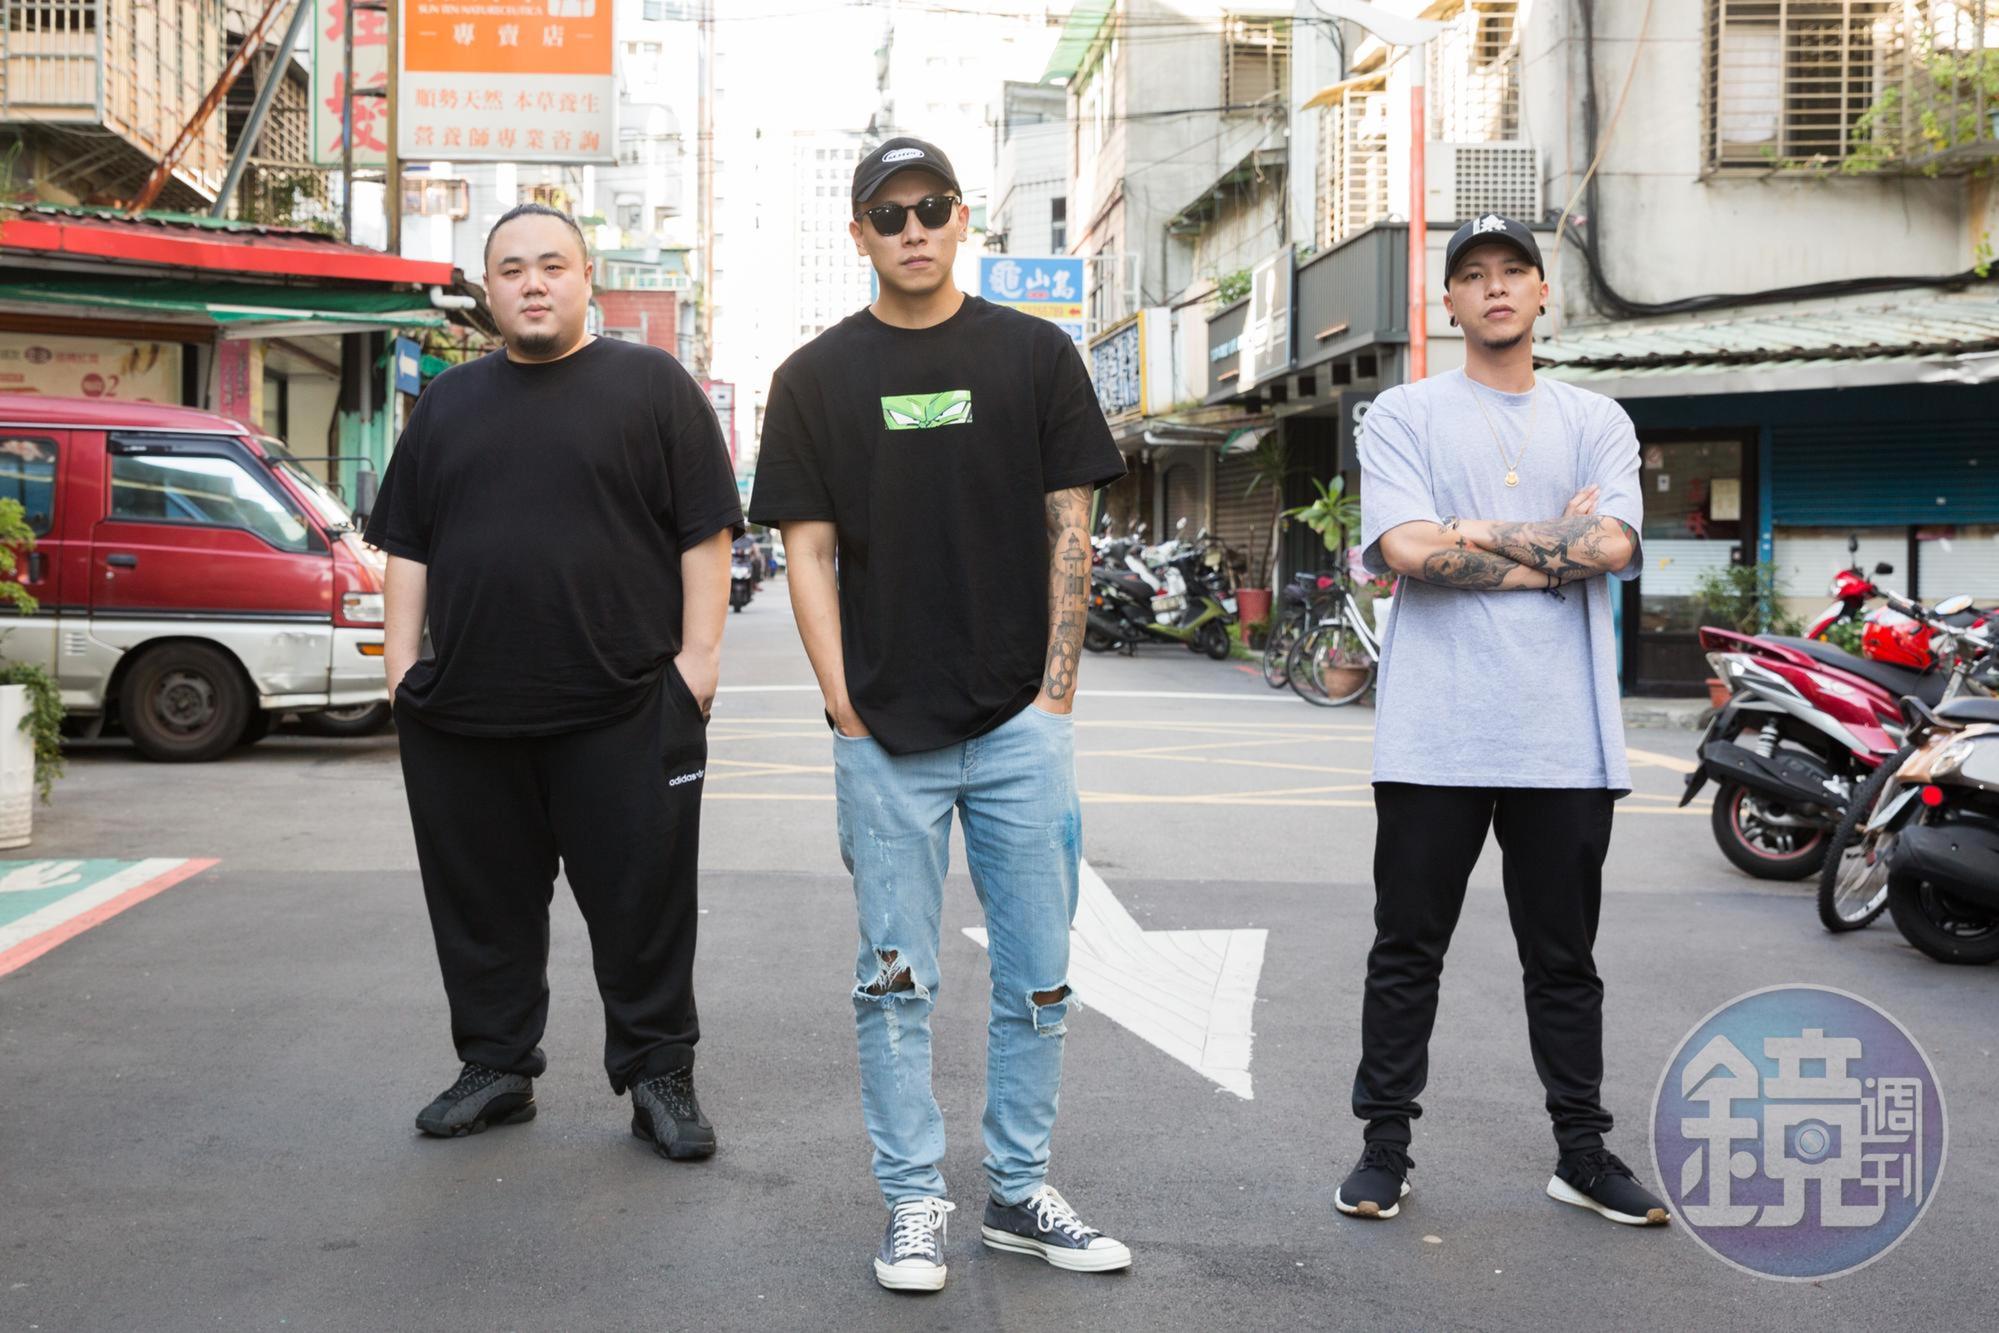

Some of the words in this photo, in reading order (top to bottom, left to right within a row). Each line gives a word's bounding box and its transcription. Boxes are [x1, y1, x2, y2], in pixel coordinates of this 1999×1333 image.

[414, 87, 503, 110] 順勢天然
[515, 90, 600, 113] 本草養生
[669, 773, 697, 786] adidas
